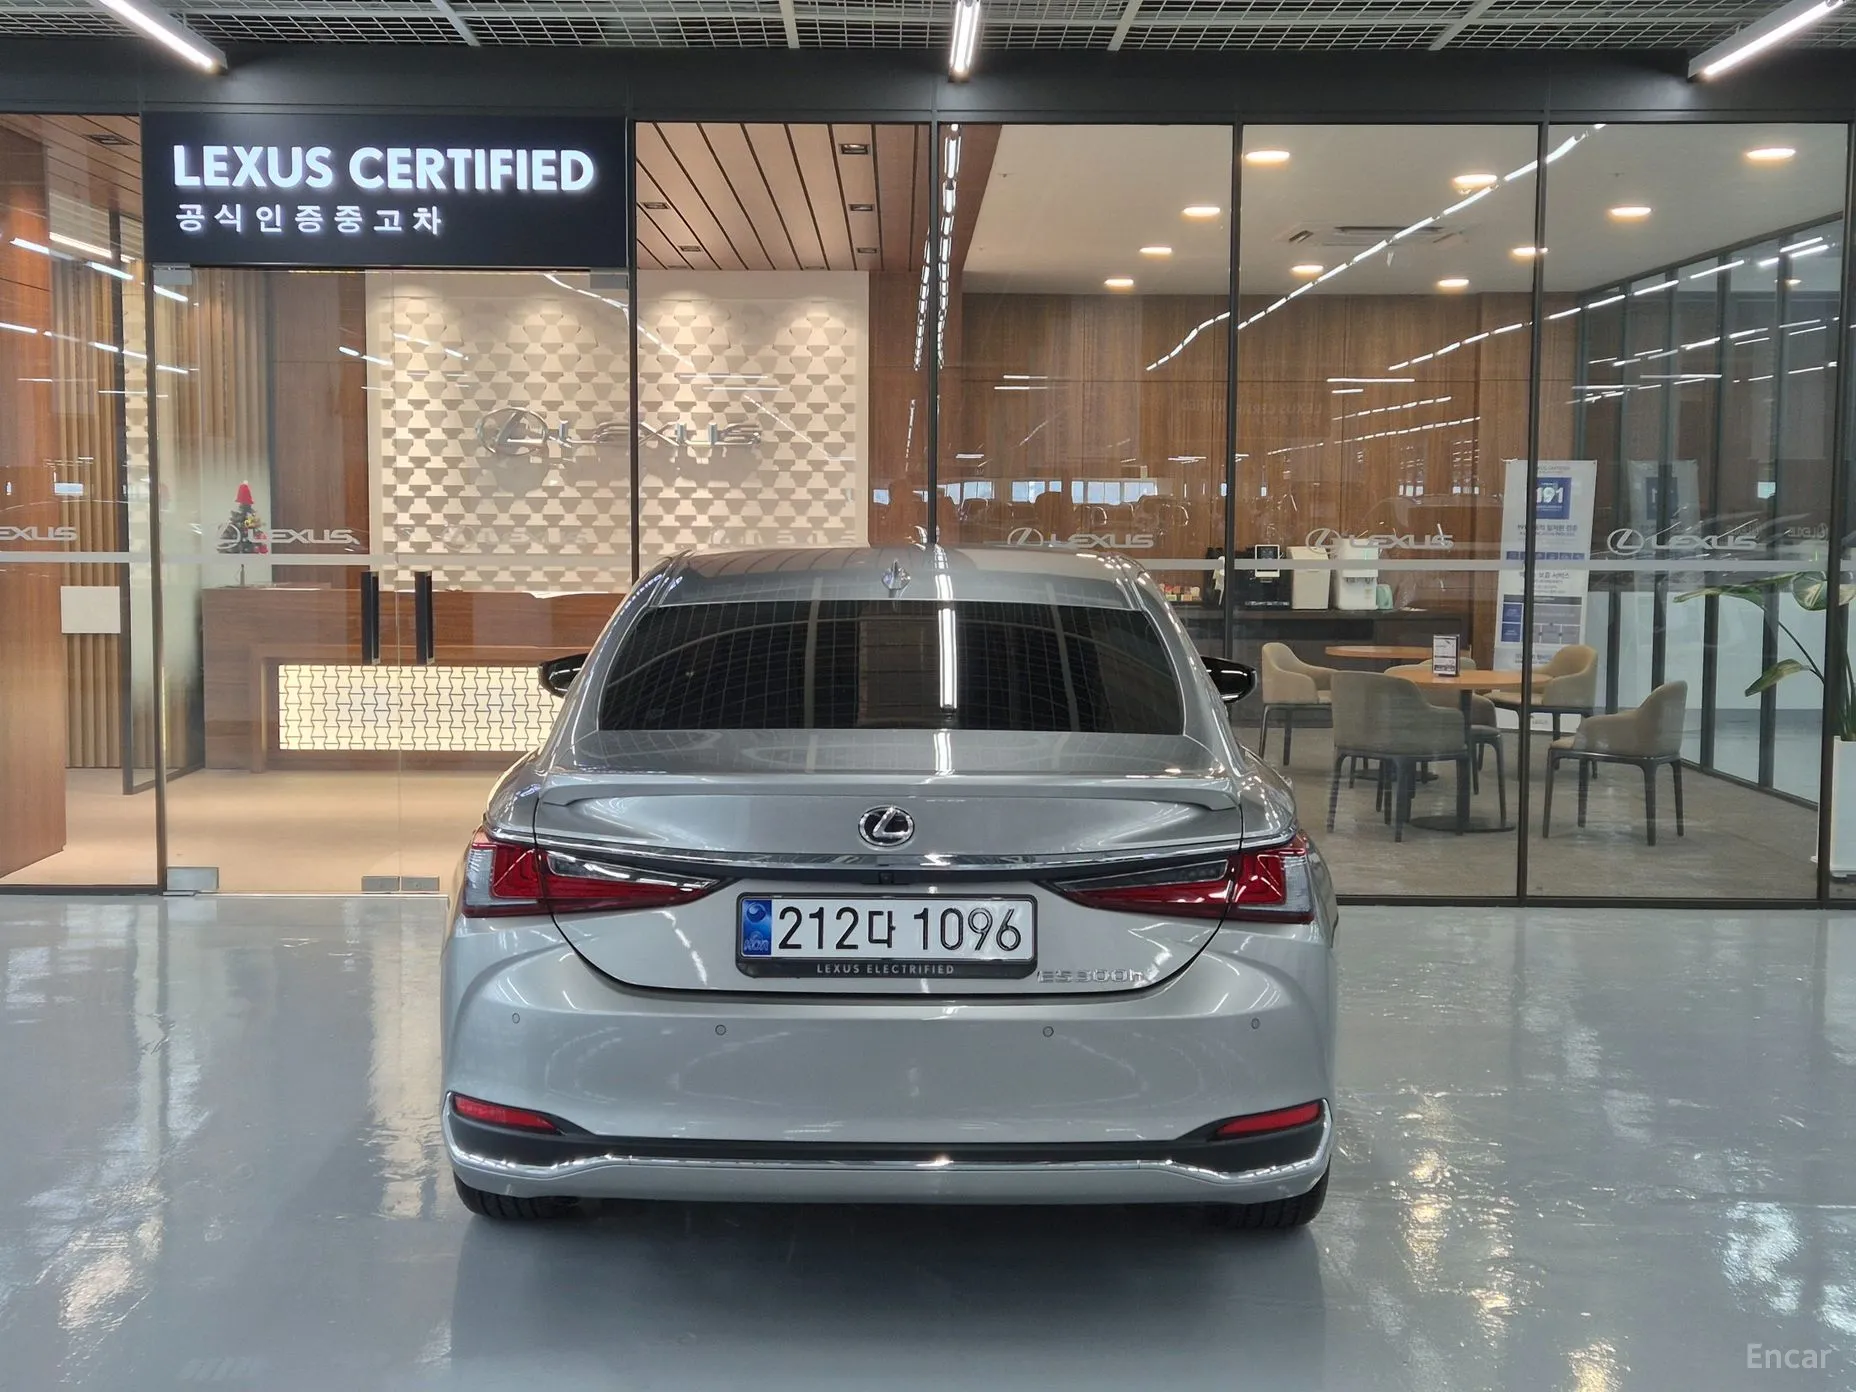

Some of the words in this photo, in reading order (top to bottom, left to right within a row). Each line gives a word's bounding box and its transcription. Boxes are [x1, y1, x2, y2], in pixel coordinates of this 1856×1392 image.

[173, 144, 332, 190] LEXUS
[349, 146, 595, 192] CERTIFIED
[176, 202, 443, 236] 공식인증중고차
[247, 528, 356, 544] LEXUS
[1048, 533, 1154, 549] LEXUS
[1349, 534, 1455, 550] LEXUS
[1651, 534, 1758, 550] LEXUS
[778, 906, 896, 950] 212다
[913, 907, 1022, 951] 1096
[816, 963, 861, 975] LEXUS
[866, 964, 955, 975] ELECTRIFIED
